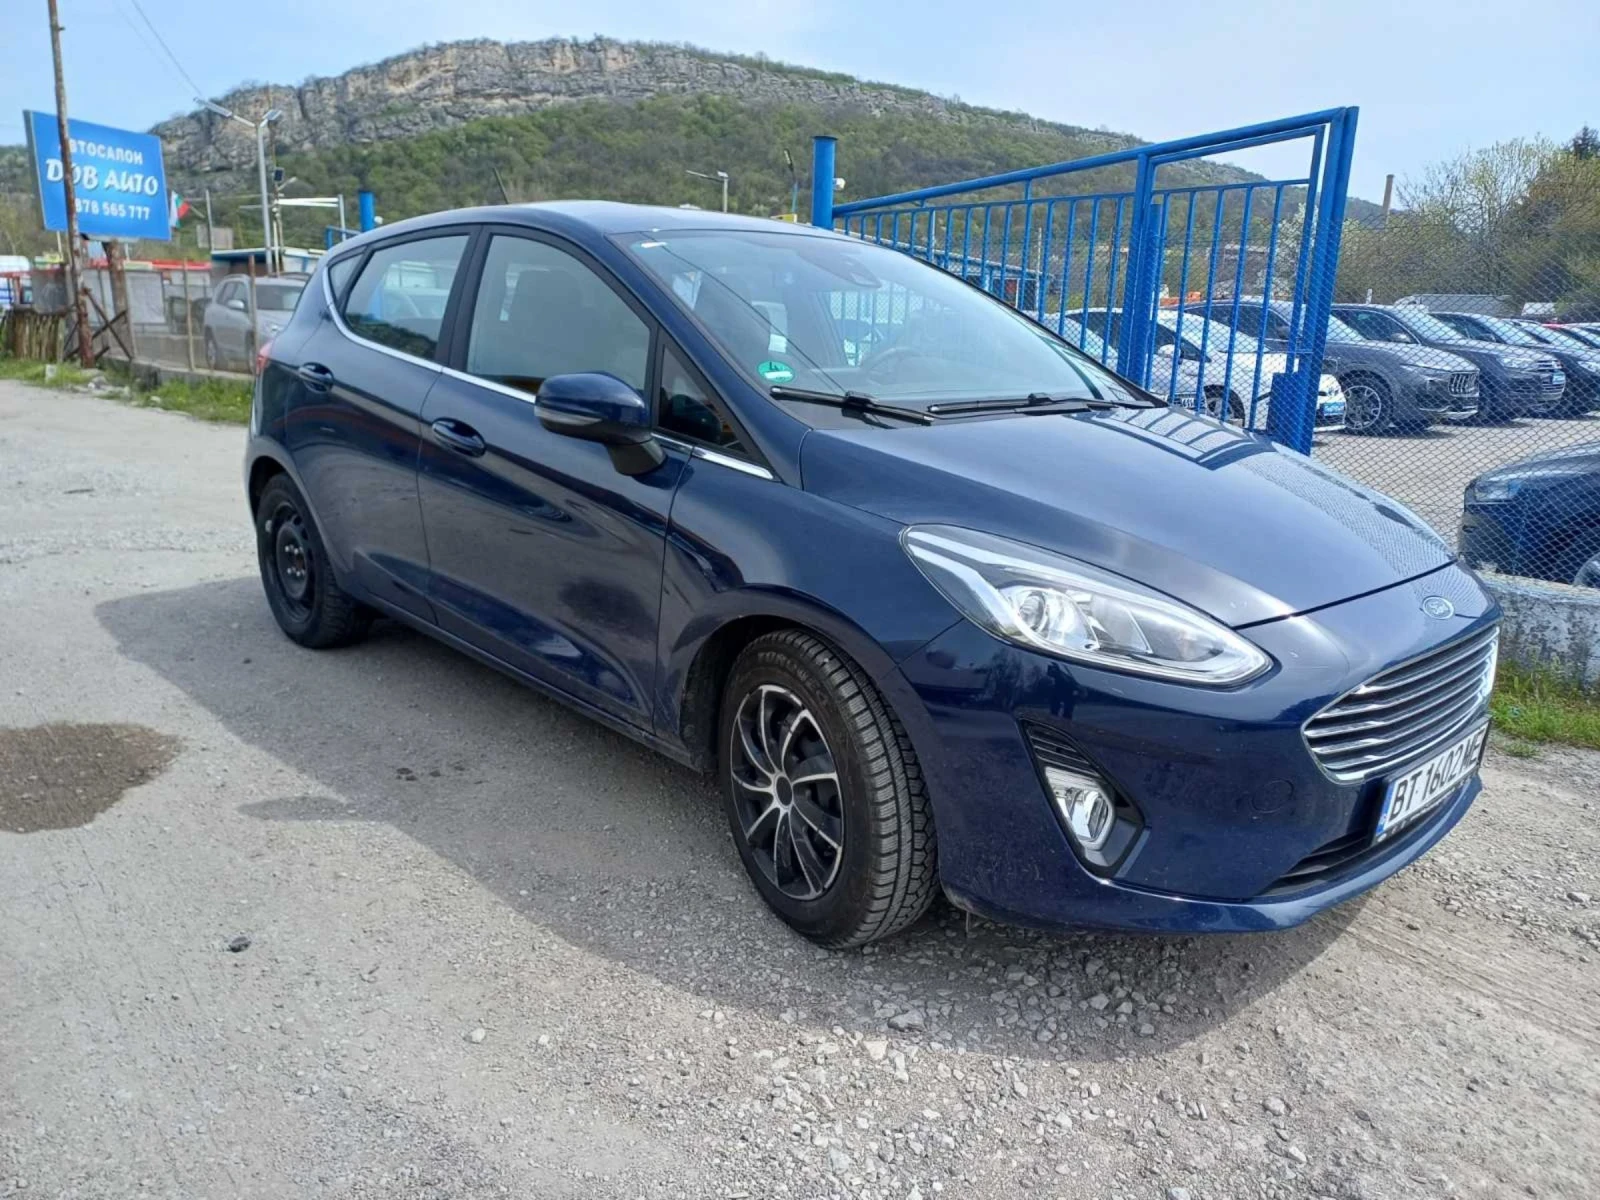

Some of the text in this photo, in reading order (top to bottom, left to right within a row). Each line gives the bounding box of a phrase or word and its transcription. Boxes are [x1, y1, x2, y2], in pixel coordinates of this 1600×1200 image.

[58, 138, 144, 165] ВТОСАЛОН
[104, 168, 159, 196] AUTO
[128, 205, 151, 220] 777
[1388, 769, 1423, 821] BT
[1422, 743, 1464, 801] 1602
